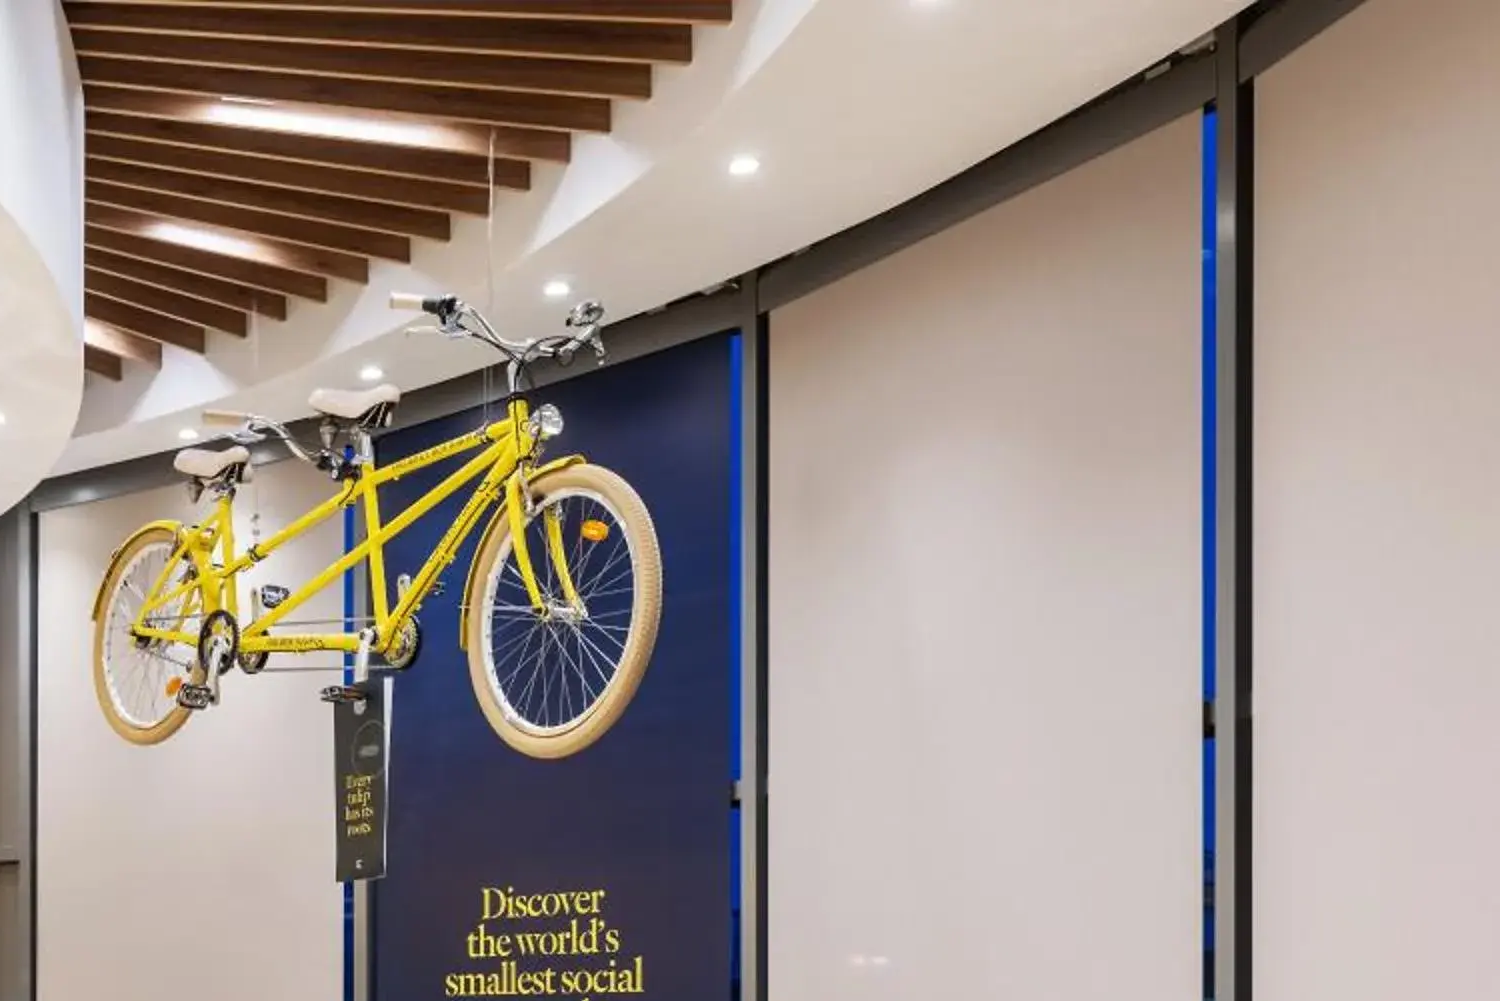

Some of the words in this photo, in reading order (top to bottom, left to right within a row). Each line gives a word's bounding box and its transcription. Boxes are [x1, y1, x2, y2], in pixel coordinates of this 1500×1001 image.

[481, 886, 605, 920] Discover
[467, 924, 511, 958] the
[515, 917, 621, 956] world's
[444, 960, 556, 997] smallest
[560, 956, 644, 994] social
